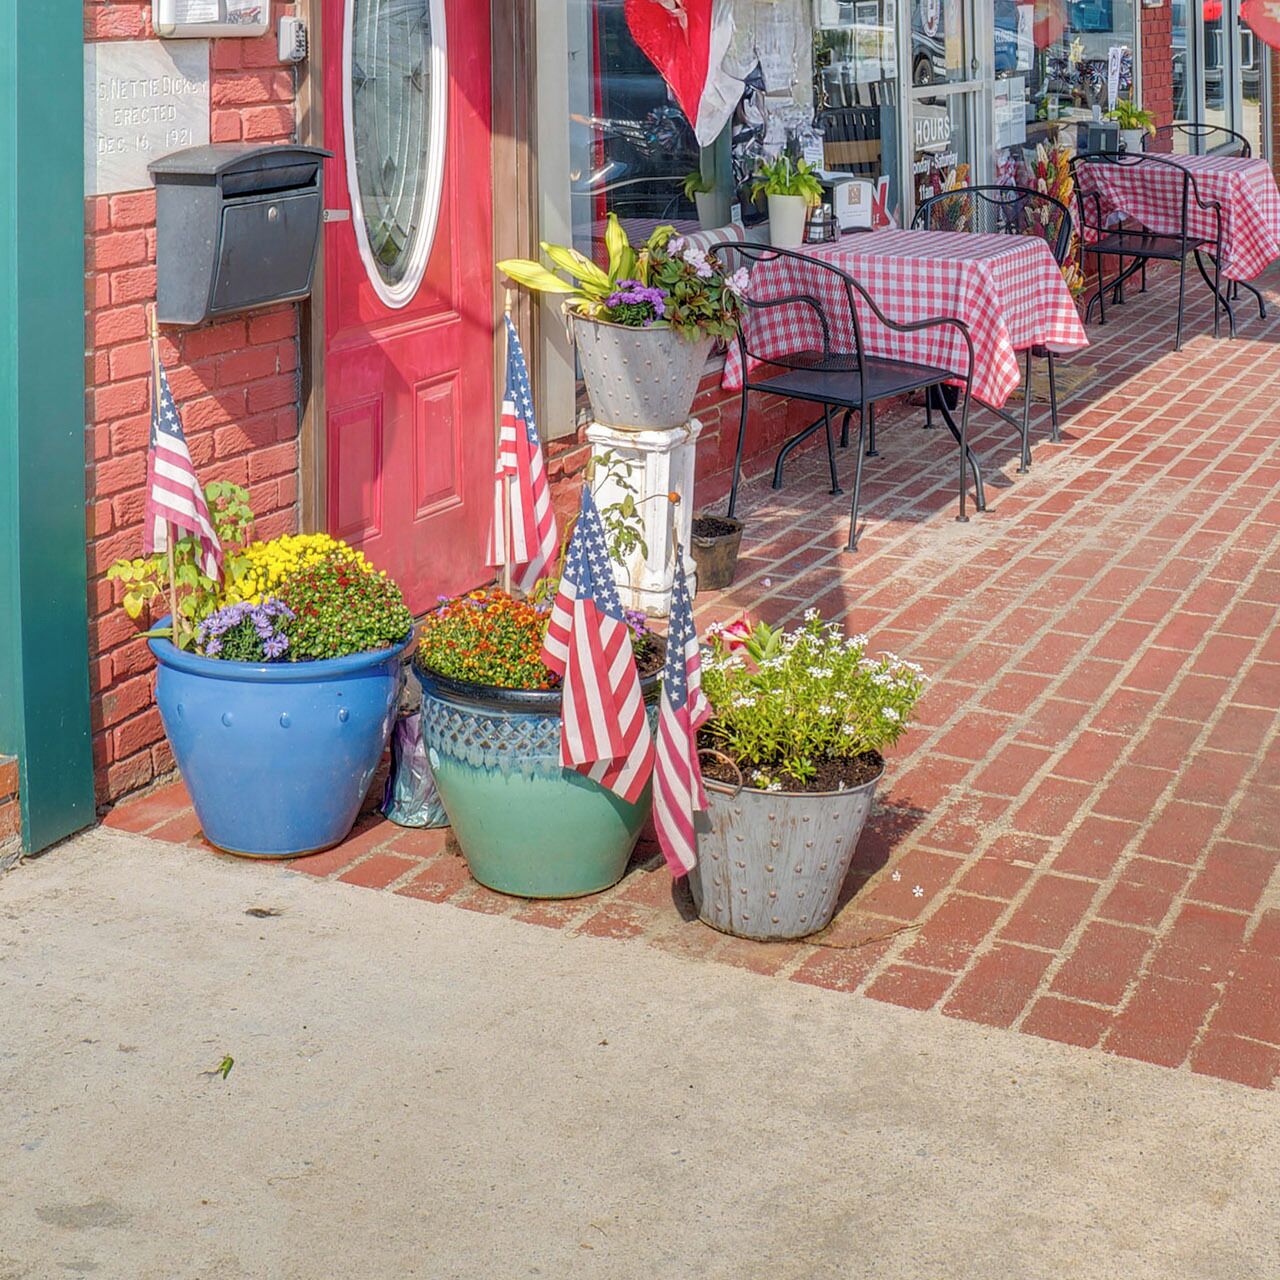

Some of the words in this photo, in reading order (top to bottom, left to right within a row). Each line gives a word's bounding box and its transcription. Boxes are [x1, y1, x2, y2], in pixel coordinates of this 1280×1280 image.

[114, 104, 177, 127] ERECTED
[165, 128, 193, 148] 1921
[915, 115, 951, 145] HOURS
[913, 158, 931, 176] onday
